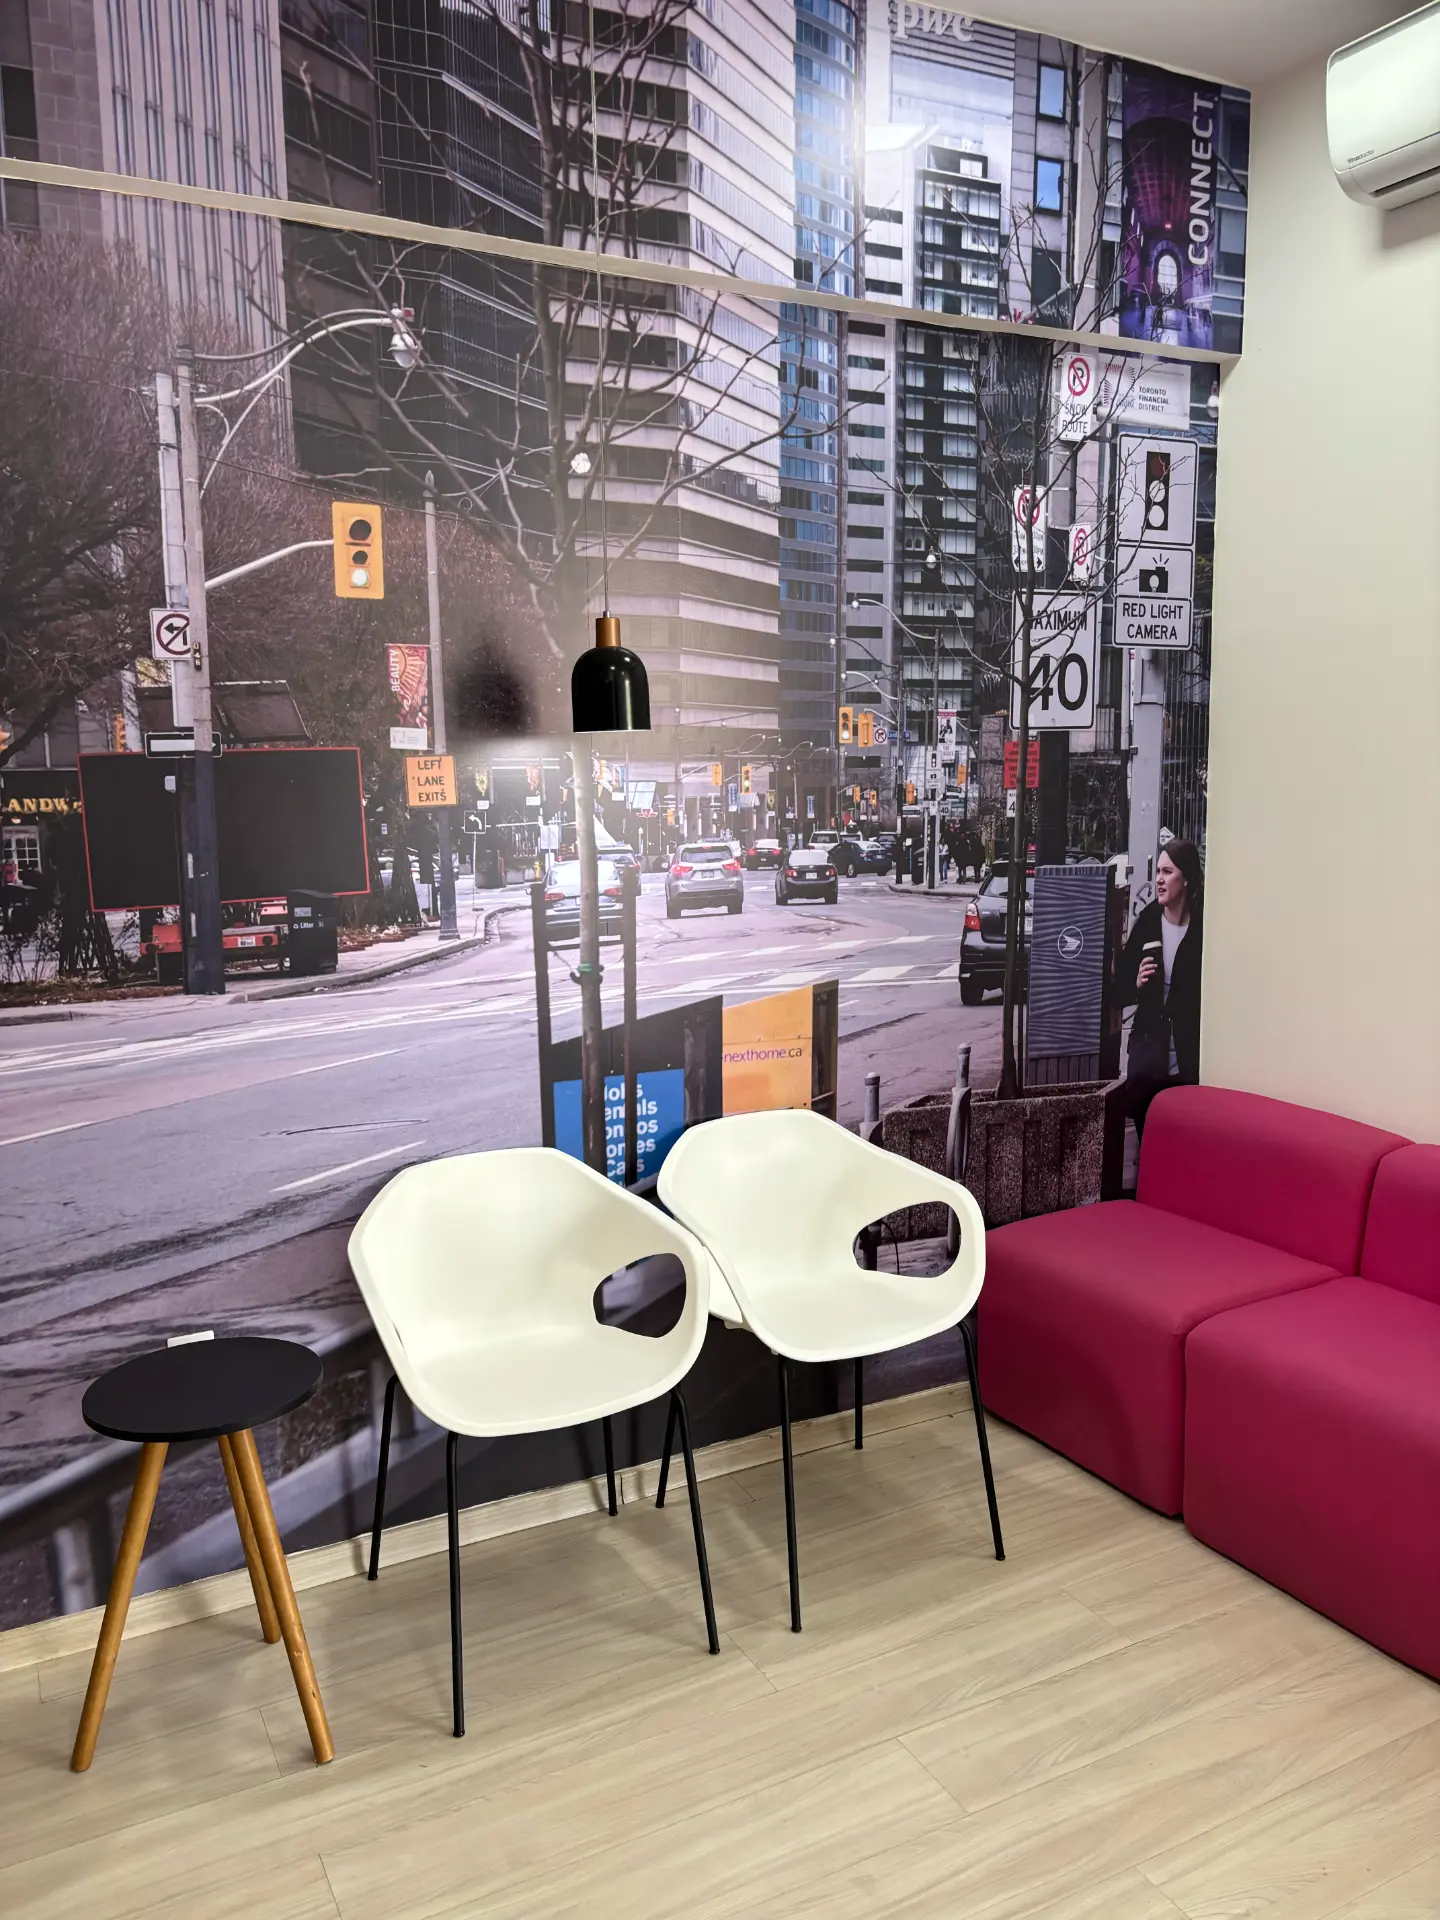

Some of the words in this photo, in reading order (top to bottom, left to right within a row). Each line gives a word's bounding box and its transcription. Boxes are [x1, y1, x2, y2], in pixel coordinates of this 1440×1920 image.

[895, 1, 975, 42] pwc
[1187, 91, 1214, 266] CONNECT
[1138, 386, 1167, 396] TORONTO
[1138, 395, 1170, 405] FINANCIAL
[1138, 403, 1165, 413] DISTRICT
[1064, 402, 1088, 416] SNOW
[1062, 419, 1089, 434] ROUTE
[1122, 602, 1146, 618] RED
[1150, 603, 1184, 620] LIGHT
[1030, 609, 1088, 631] AXIMUM
[1126, 623, 1178, 641] CAMERA
[389, 648, 401, 692] BEAUTY
[1029, 652, 1089, 711] 40
[417, 759, 443, 771] LEFT
[417, 775, 445, 787] LANE
[418, 791, 447, 803] EXITS
[723, 1047, 803, 1063] nexthome.ca
[605, 1119, 659, 1140] onos
[607, 1159, 645, 1177] Cas
